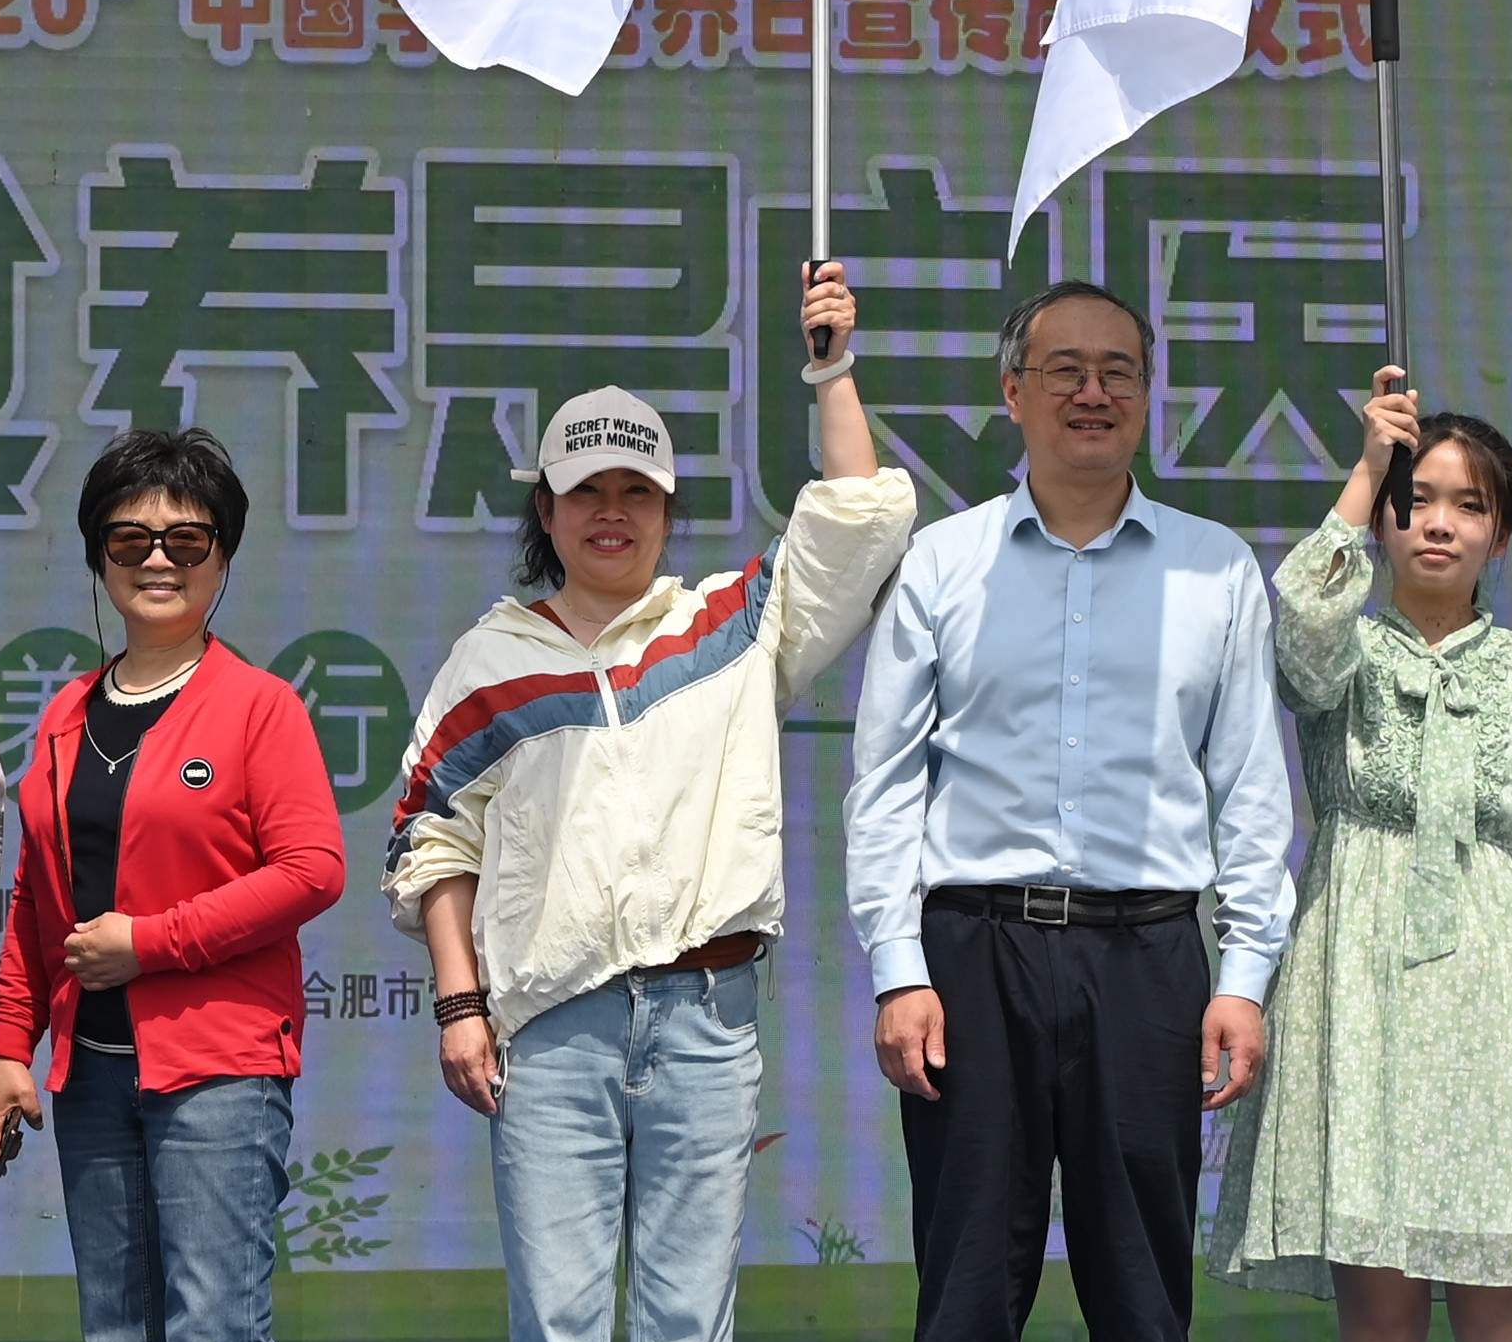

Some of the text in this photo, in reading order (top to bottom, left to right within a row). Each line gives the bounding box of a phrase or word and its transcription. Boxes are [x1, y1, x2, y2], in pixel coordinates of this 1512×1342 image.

[564, 417, 659, 444] SECRET WEAPON
[565, 432, 657, 458] NEVER MOMENT
[303, 970, 436, 1020] 合肥市
